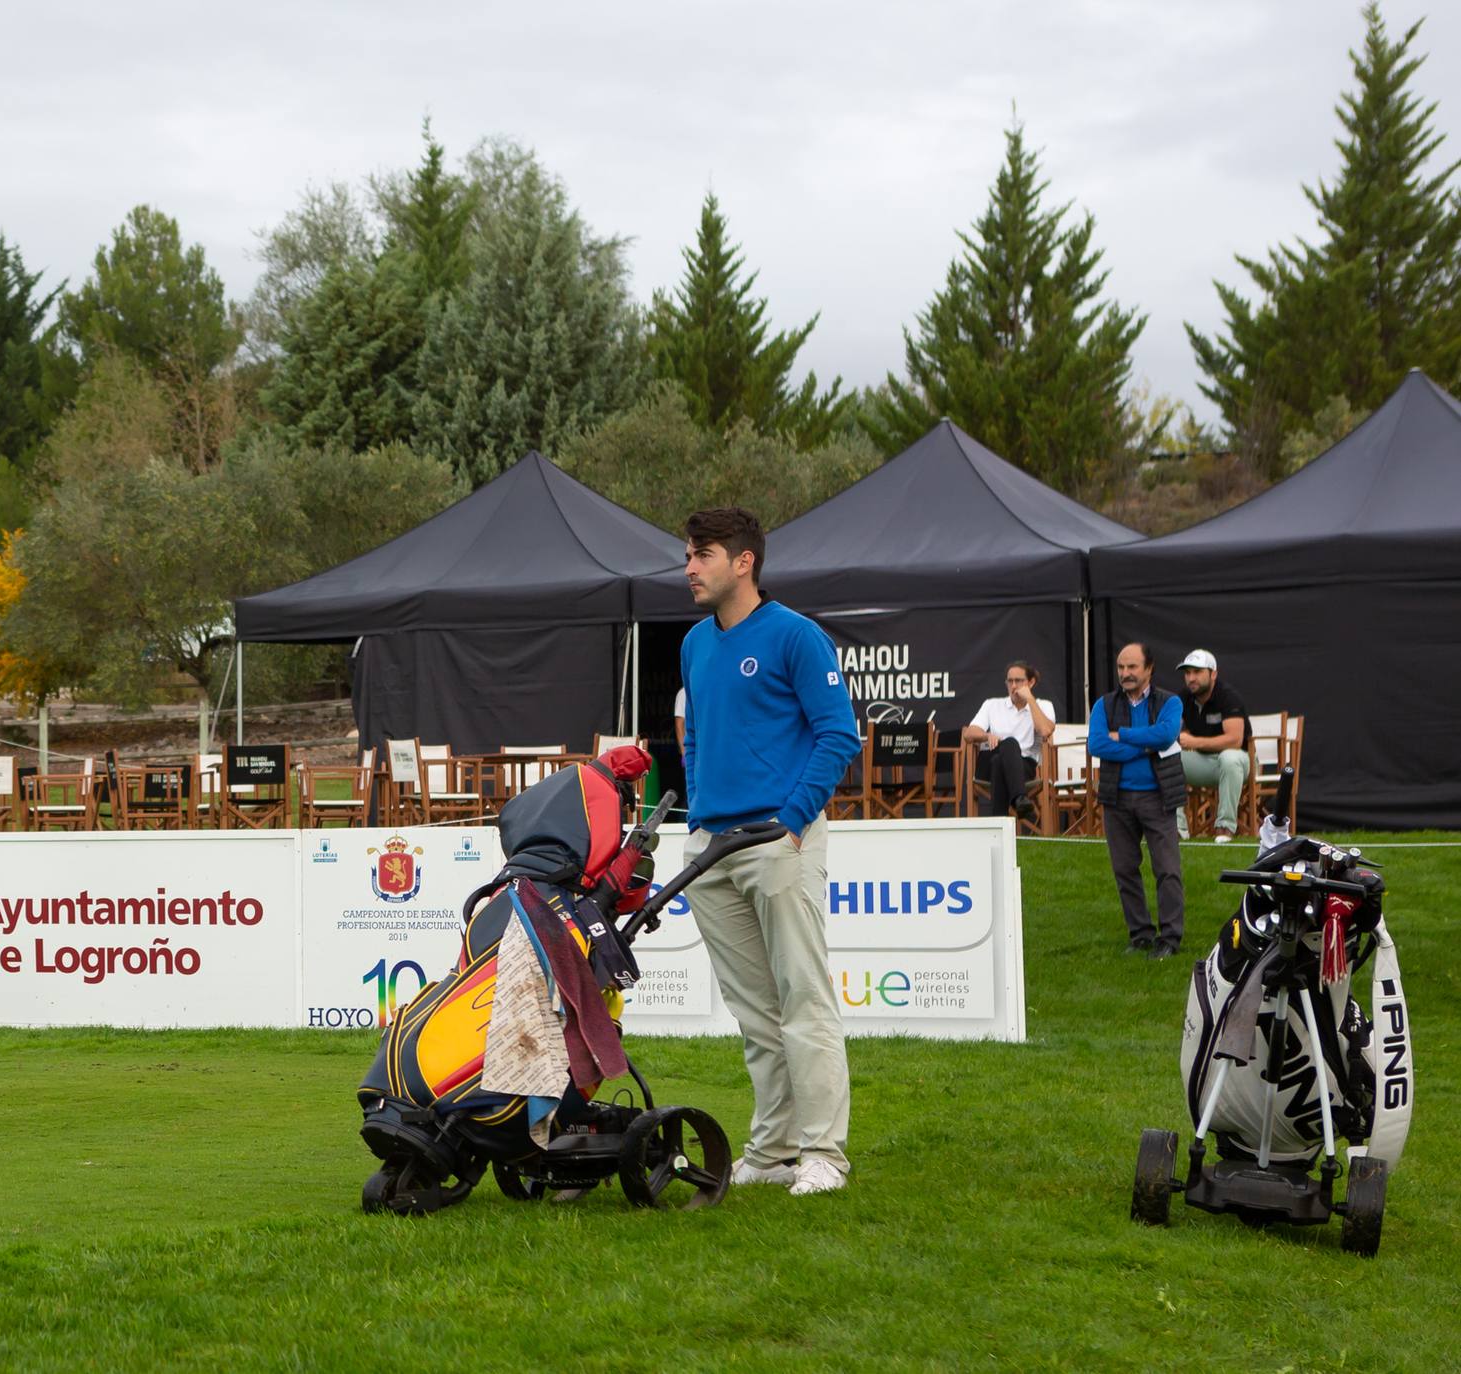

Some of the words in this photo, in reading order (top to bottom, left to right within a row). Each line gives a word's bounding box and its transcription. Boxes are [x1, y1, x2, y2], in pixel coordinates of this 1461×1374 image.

[849, 672, 956, 700] NMIGUEL
[829, 880, 973, 915] HILIPS
[342, 910, 404, 919] CAMPEONATO
[406, 911, 419, 919] DE
[420, 908, 455, 919] ESPAÑA
[337, 921, 406, 930] PROFESIONALES
[407, 921, 461, 930] MASCULINO
[388, 932, 408, 941] 2019
[35, 937, 202, 985] Logroño
[914, 969, 969, 981] personal
[637, 980, 689, 991] wireless
[829, 970, 911, 1007] ue
[914, 982, 970, 994] wireless
[637, 993, 685, 1006] lighting
[914, 995, 966, 1009] lighting
[308, 1007, 374, 1028] HOYO
[1381, 1002, 1408, 1110] PING
